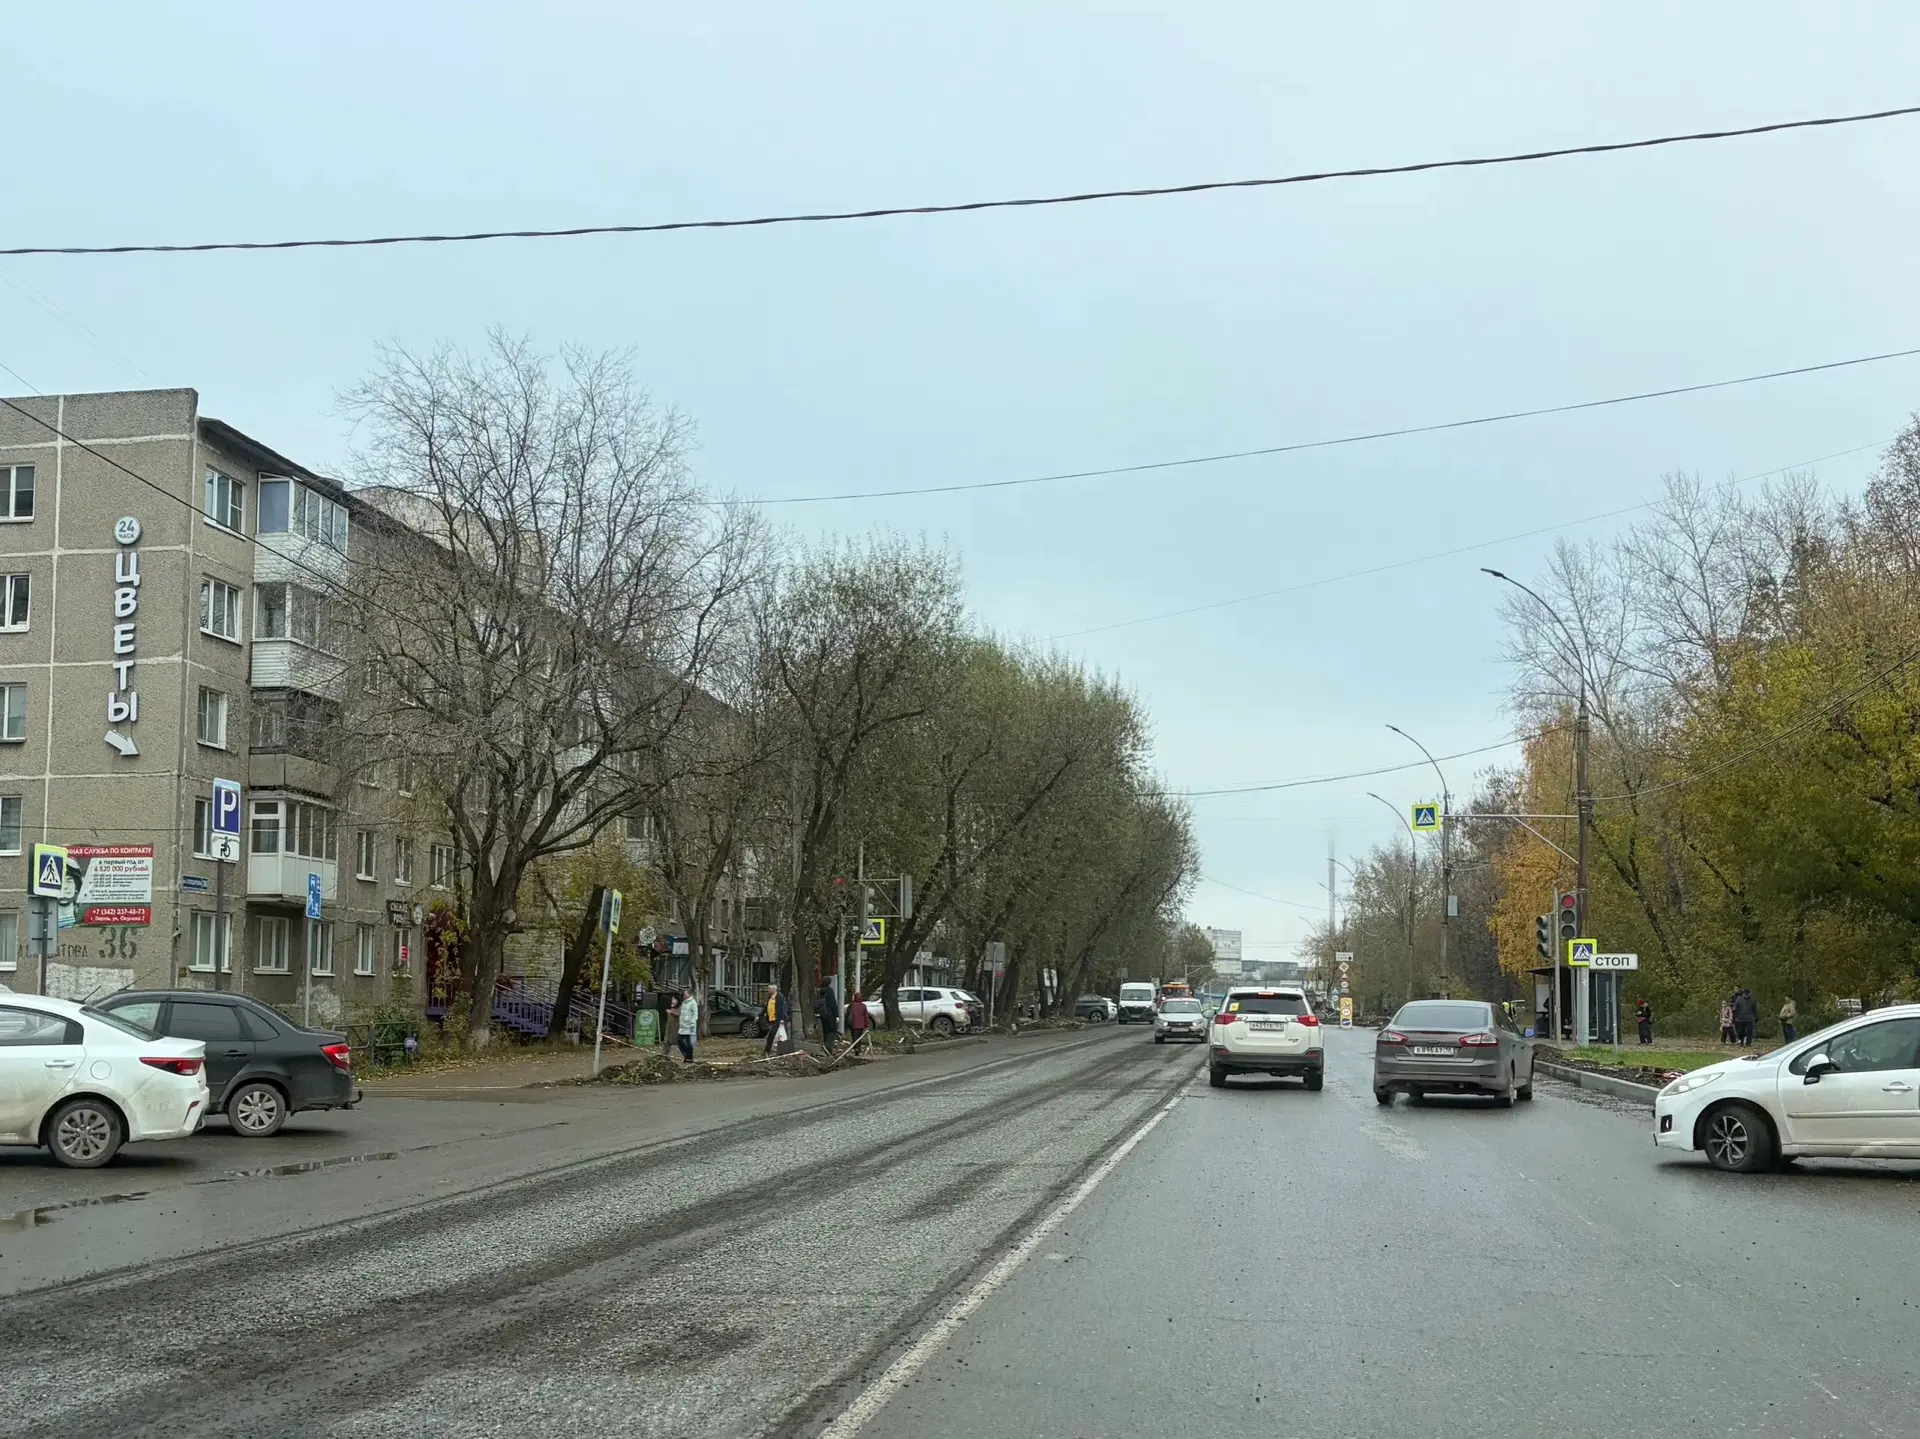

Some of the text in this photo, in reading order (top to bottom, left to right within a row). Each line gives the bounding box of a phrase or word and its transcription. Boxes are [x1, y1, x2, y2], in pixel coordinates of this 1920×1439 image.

[118, 519, 135, 533] 24
[108, 553, 140, 722] ЦВЕТЫ
[84, 847, 109, 855] СЛУЖБА
[120, 846, 152, 854] КОНТРАКТУ
[103, 859, 126, 867] первый
[124, 865, 149, 873] рублей
[98, 926, 138, 959] 36
[1595, 956, 1630, 967] СТОП
